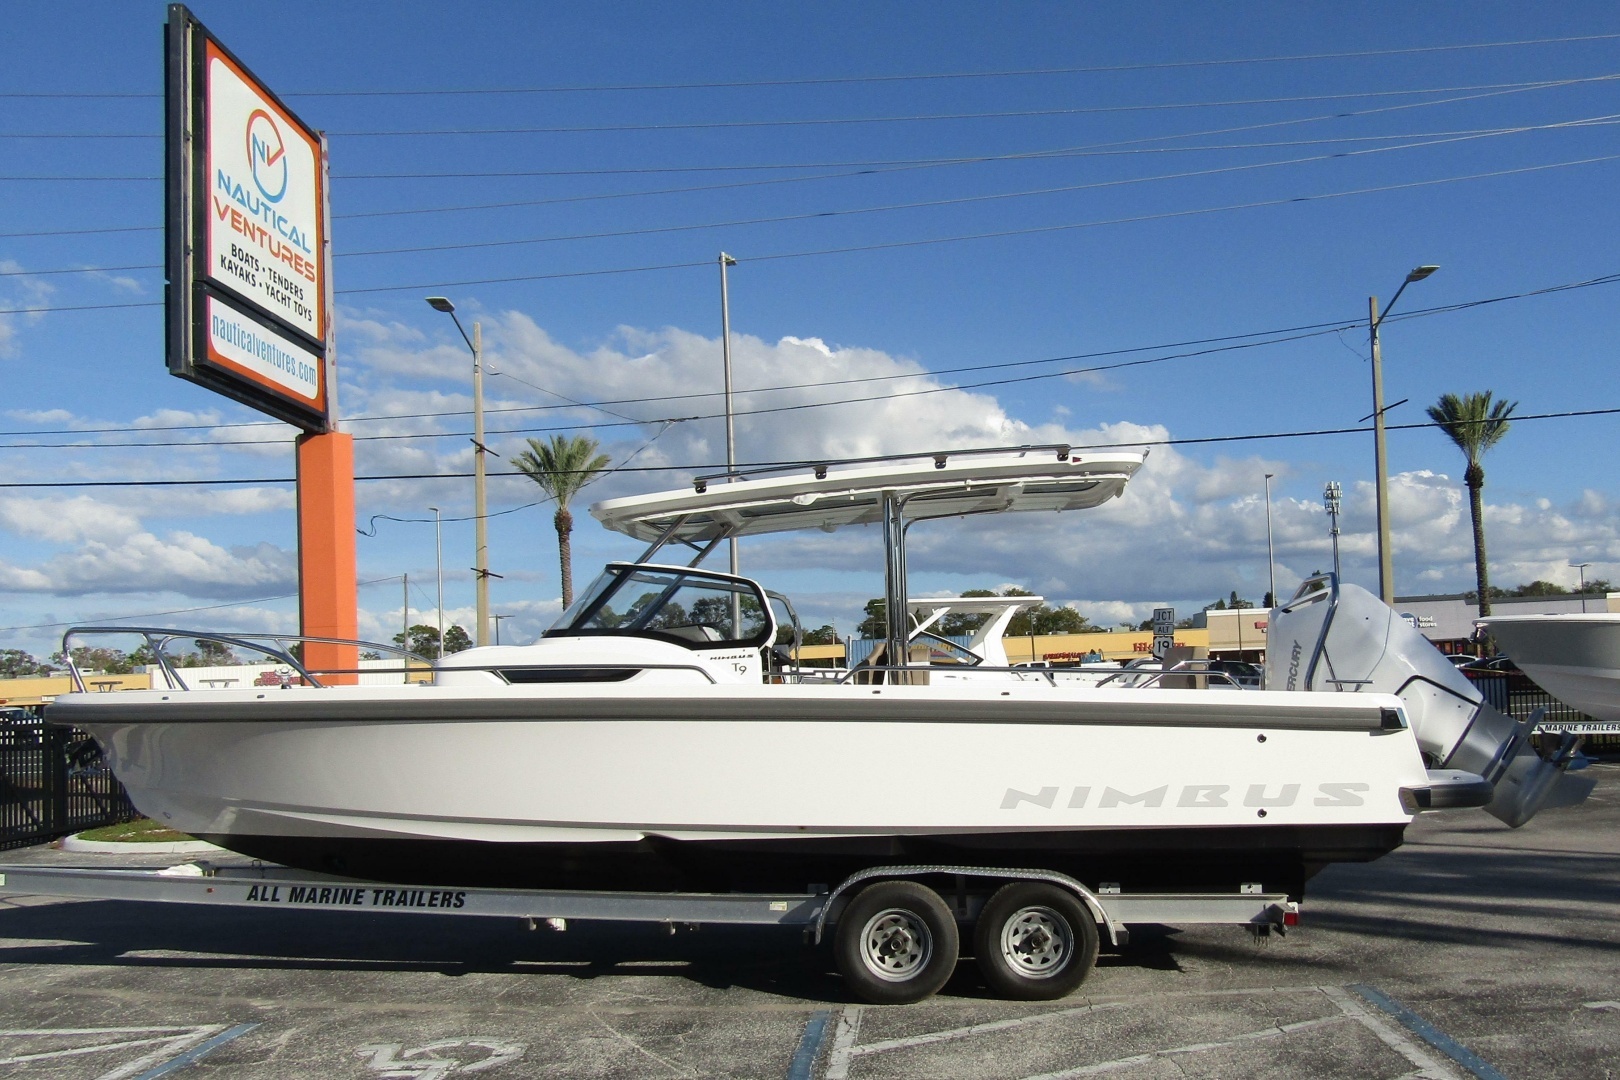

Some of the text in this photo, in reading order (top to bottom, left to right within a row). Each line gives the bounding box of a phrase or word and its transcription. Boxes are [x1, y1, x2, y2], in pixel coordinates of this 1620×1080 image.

[217, 168, 312, 254] NAUTICAL
[213, 195, 316, 283] VENTURES
[220, 254, 313, 322] KAYAKS YACHT TOYS
[231, 243, 304, 301] BOATS TENDERS
[212, 313, 317, 387] nauticalventures.com
[1156, 611, 1172, 621] JCT
[731, 662, 747, 675] T9
[1158, 641, 1170, 652] 19
[1286, 639, 1303, 691] ERCURY
[999, 782, 1370, 810] NIMBUS
[247, 885, 467, 908] ALL MARINE TRAILERS
